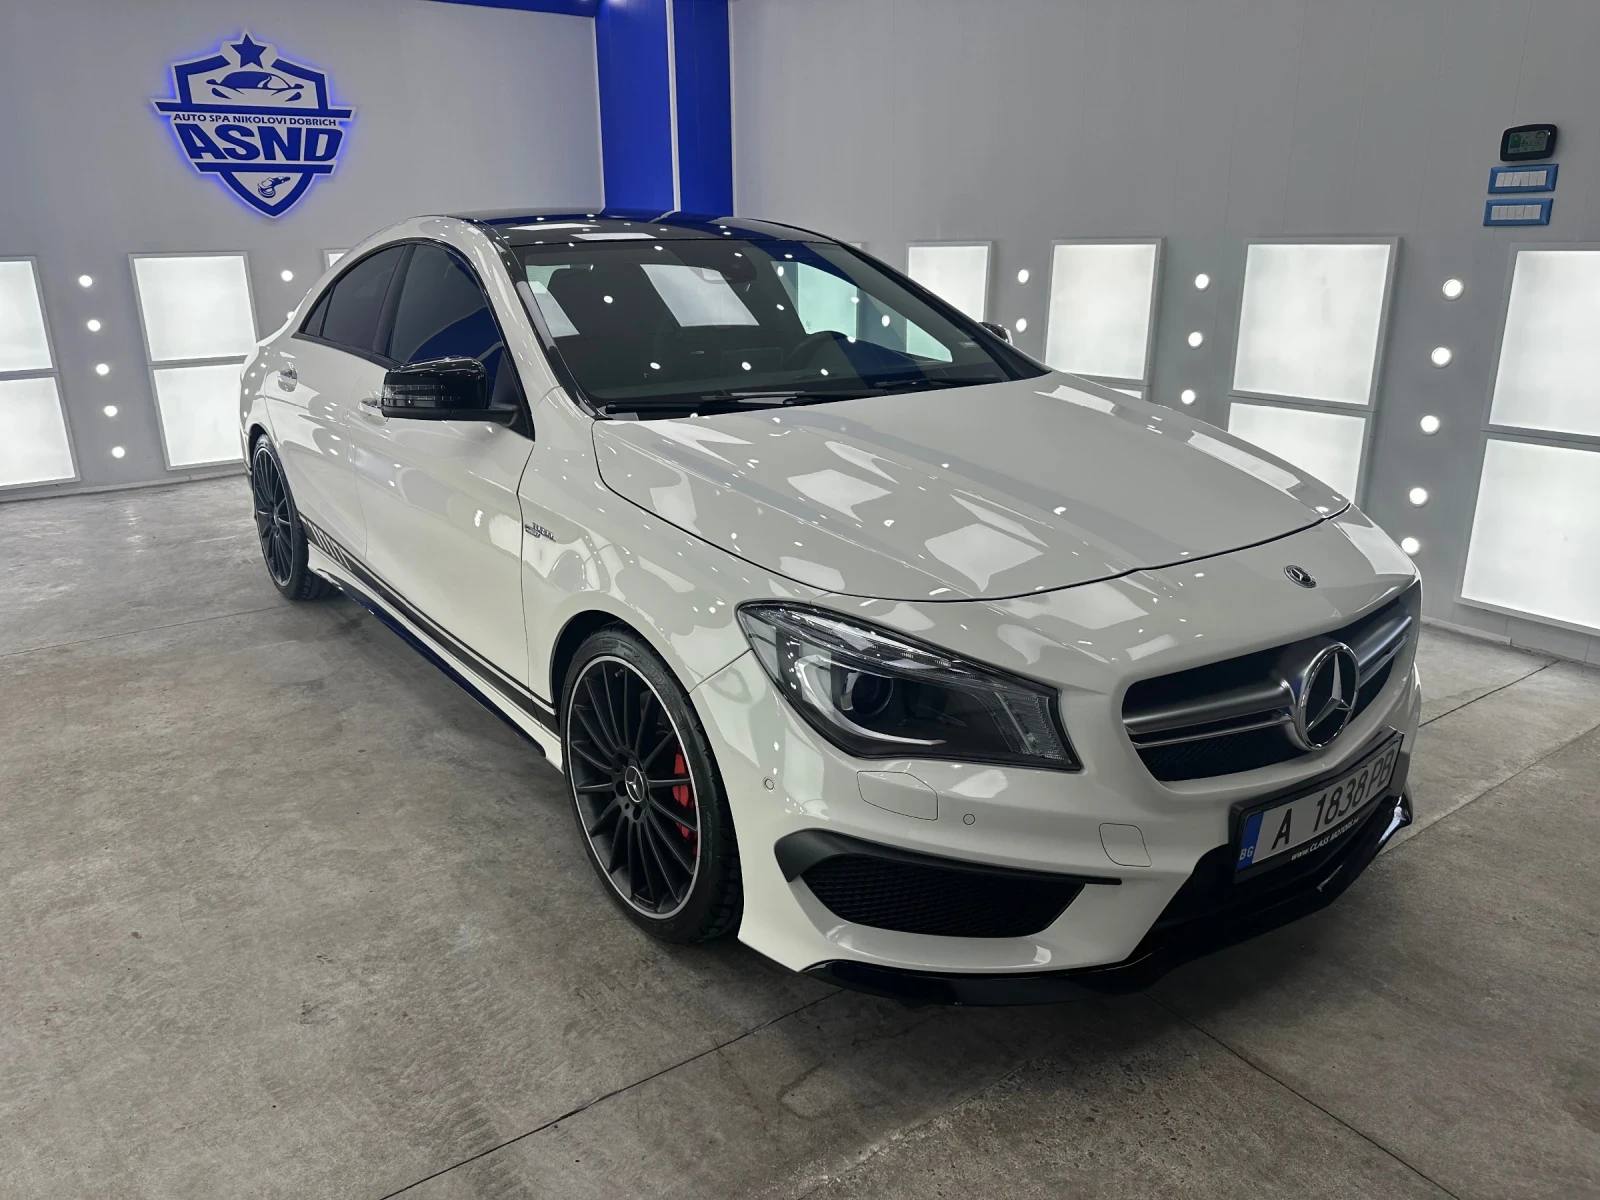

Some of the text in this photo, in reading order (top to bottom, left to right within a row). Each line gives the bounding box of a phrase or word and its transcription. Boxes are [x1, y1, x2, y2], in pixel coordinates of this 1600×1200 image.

[173, 113, 337, 126] AUTO SPA NIKOLOVI DOBRICH
[174, 123, 344, 162] ASND
[1271, 808, 1293, 850] A
[1239, 845, 1254, 861] BG
